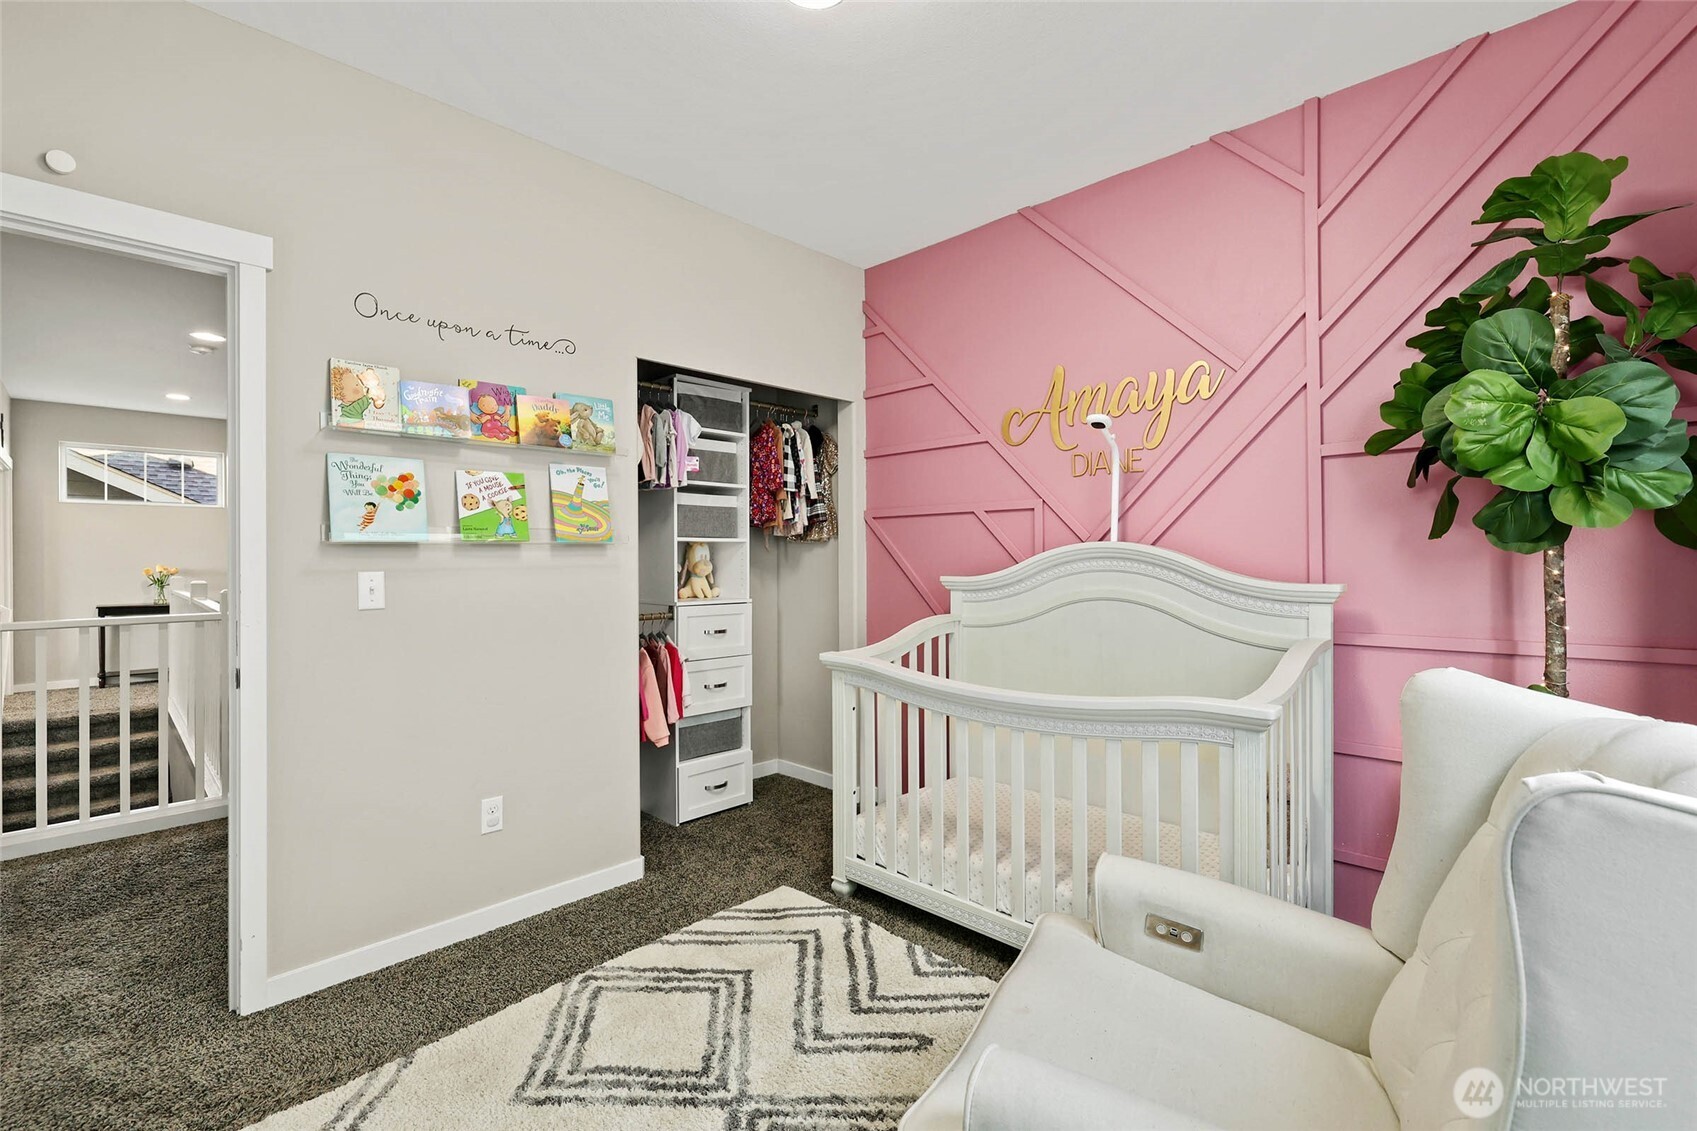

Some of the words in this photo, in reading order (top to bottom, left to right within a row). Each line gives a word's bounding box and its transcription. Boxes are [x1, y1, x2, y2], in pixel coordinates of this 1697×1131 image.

[354, 292, 421, 323] Once
[427, 317, 481, 341] upon
[486, 330, 502, 340] a
[531, 404, 560, 414] Daddy
[593, 401, 611, 413] Little
[1001, 360, 1226, 451] Amaya
[598, 410, 610, 422] Me
[331, 460, 384, 474] Wonderful
[576, 467, 593, 477] Places
[341, 470, 373, 482] Things
[350, 480, 365, 488] You
[465, 482, 473, 490] IF
[473, 478, 485, 487] YOU
[484, 476, 500, 484] GIVE
[483, 481, 504, 491] MOUSE
[343, 489, 361, 497] Will
[487, 487, 509, 499] COOKIE
